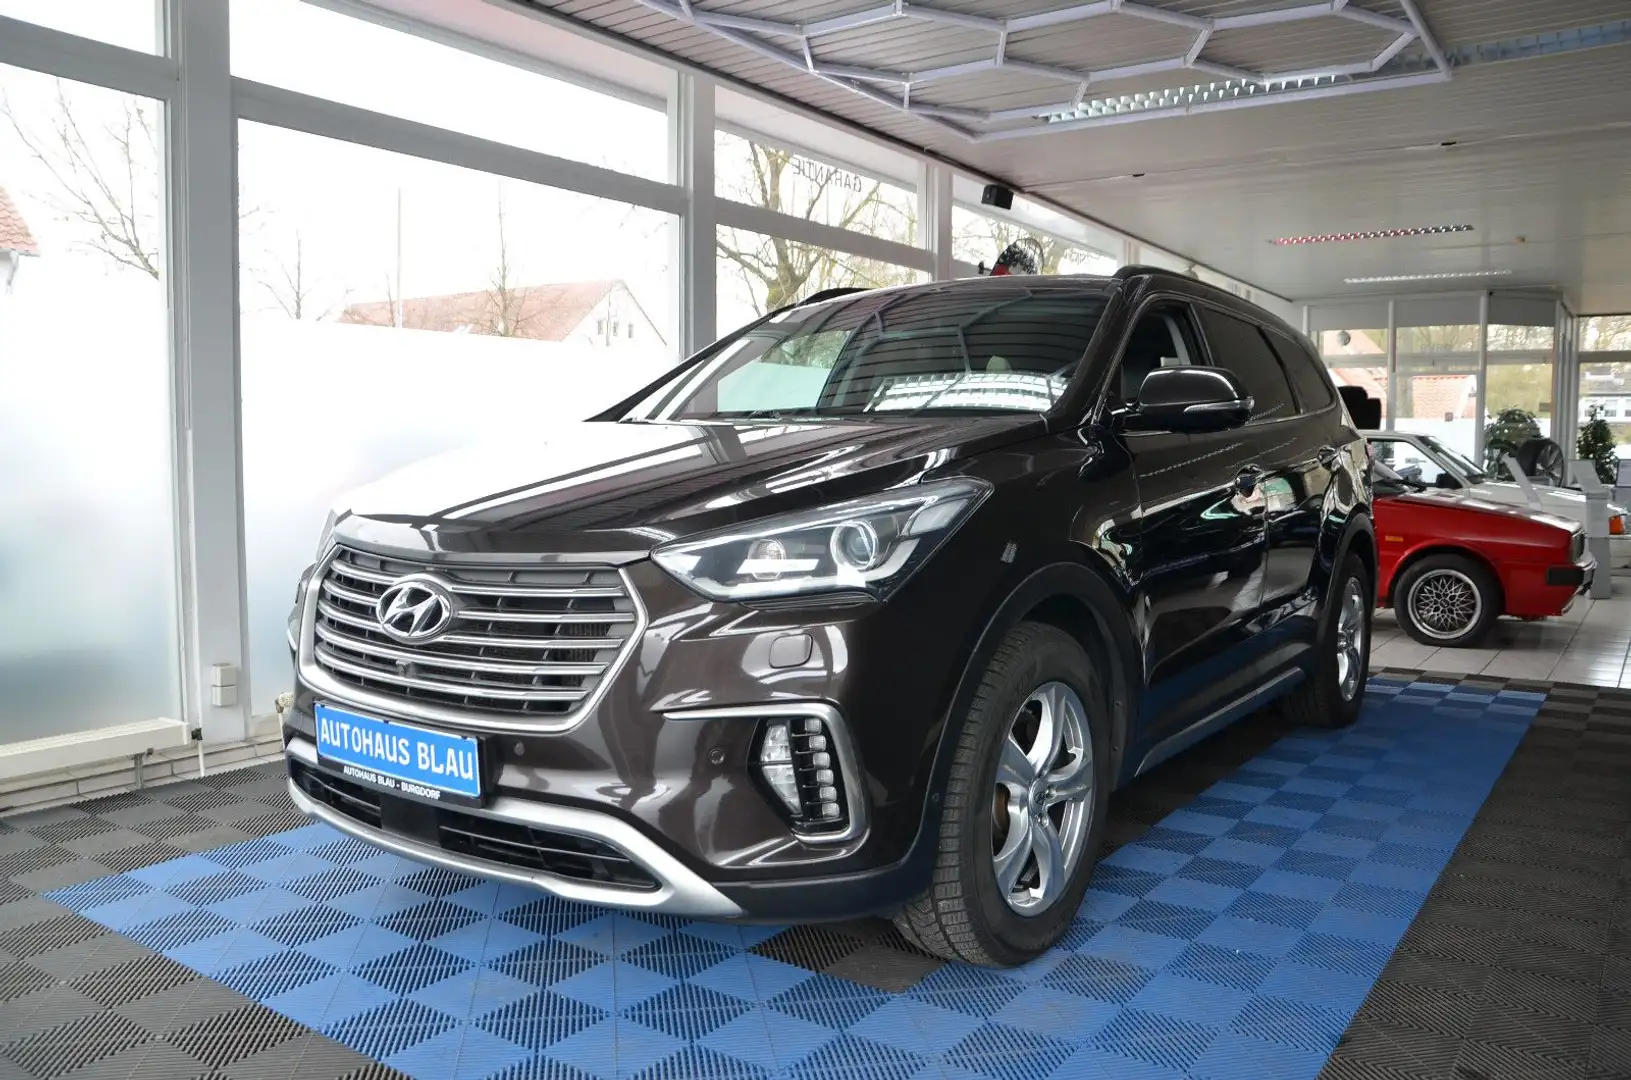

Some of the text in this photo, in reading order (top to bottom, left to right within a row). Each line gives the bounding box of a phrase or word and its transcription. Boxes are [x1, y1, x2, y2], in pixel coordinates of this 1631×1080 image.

[320, 717, 474, 781] AUTOHAUS BLAU
[343, 765, 377, 783] AUTOHAUS
[377, 775, 396, 789] BLAU
[401, 781, 441, 800] BURGDORF
